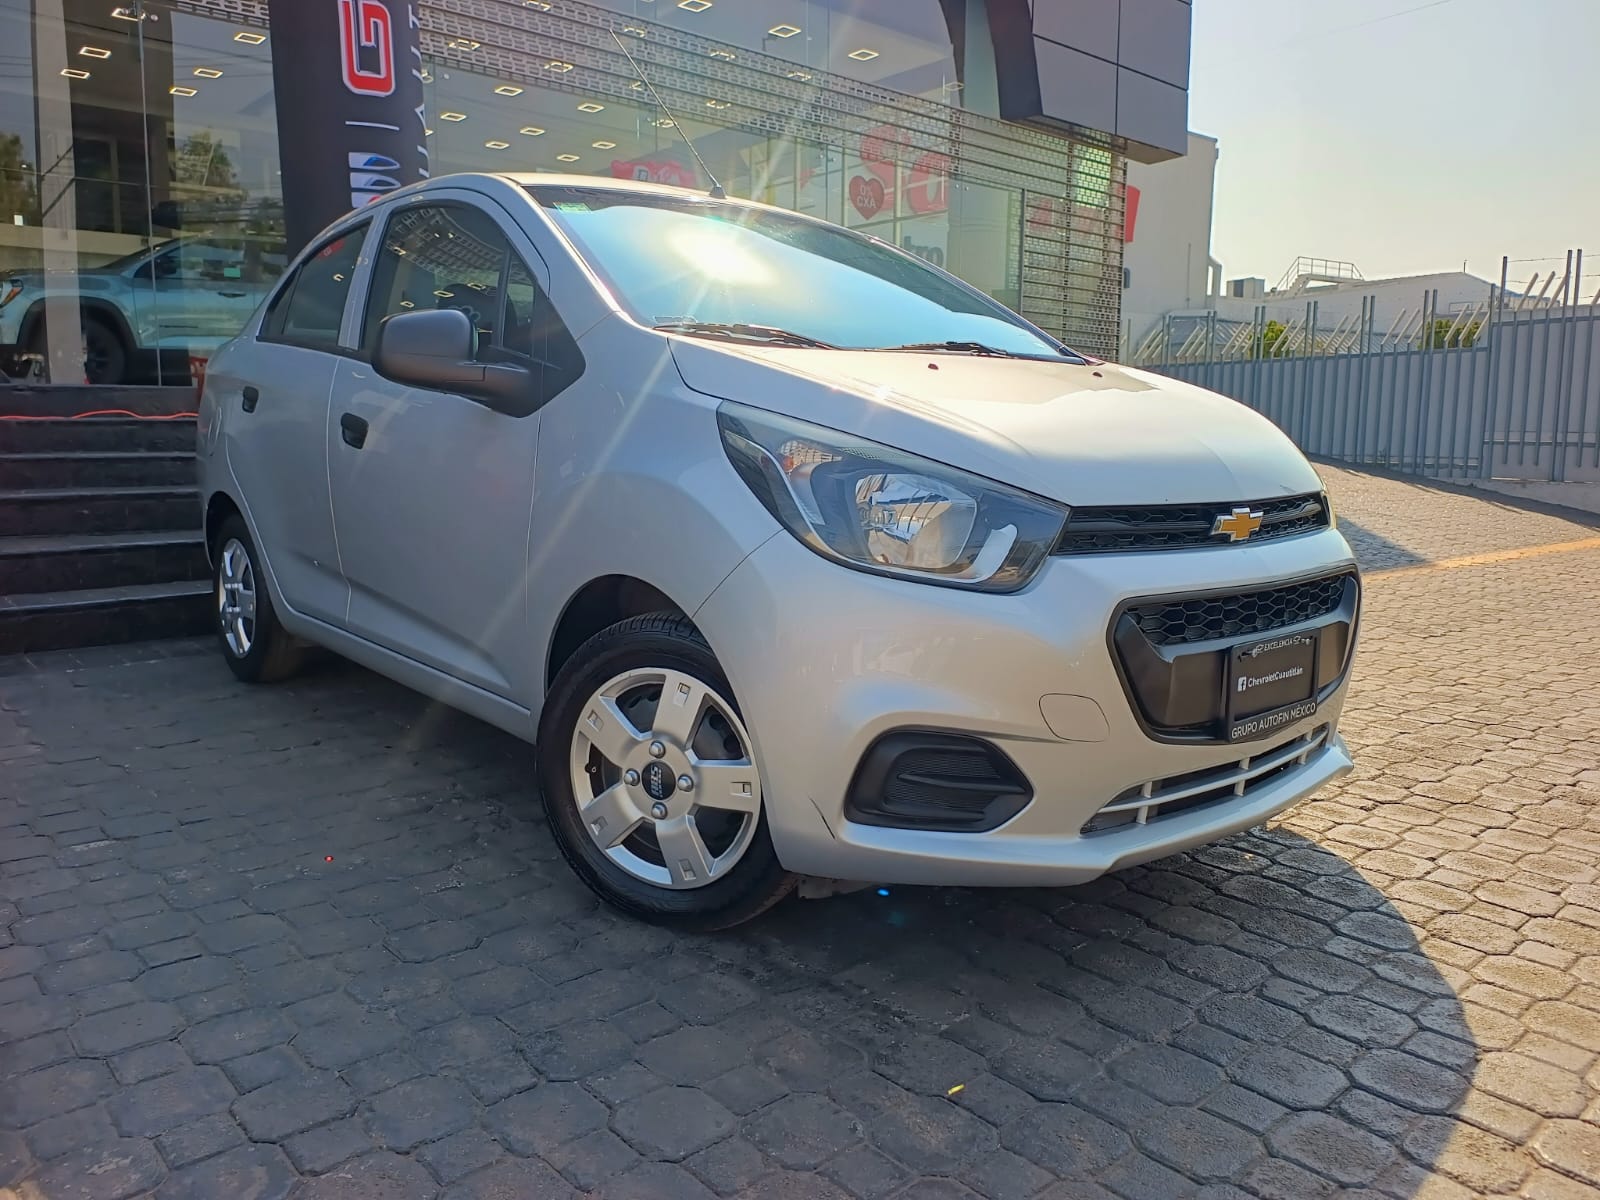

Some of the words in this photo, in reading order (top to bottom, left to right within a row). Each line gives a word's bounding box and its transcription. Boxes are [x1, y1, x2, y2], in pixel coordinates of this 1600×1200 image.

[1231, 721, 1258, 739] GRUPO
[1258, 711, 1290, 730] AUTOFIN
[1290, 702, 1316, 720] MÉXICO
